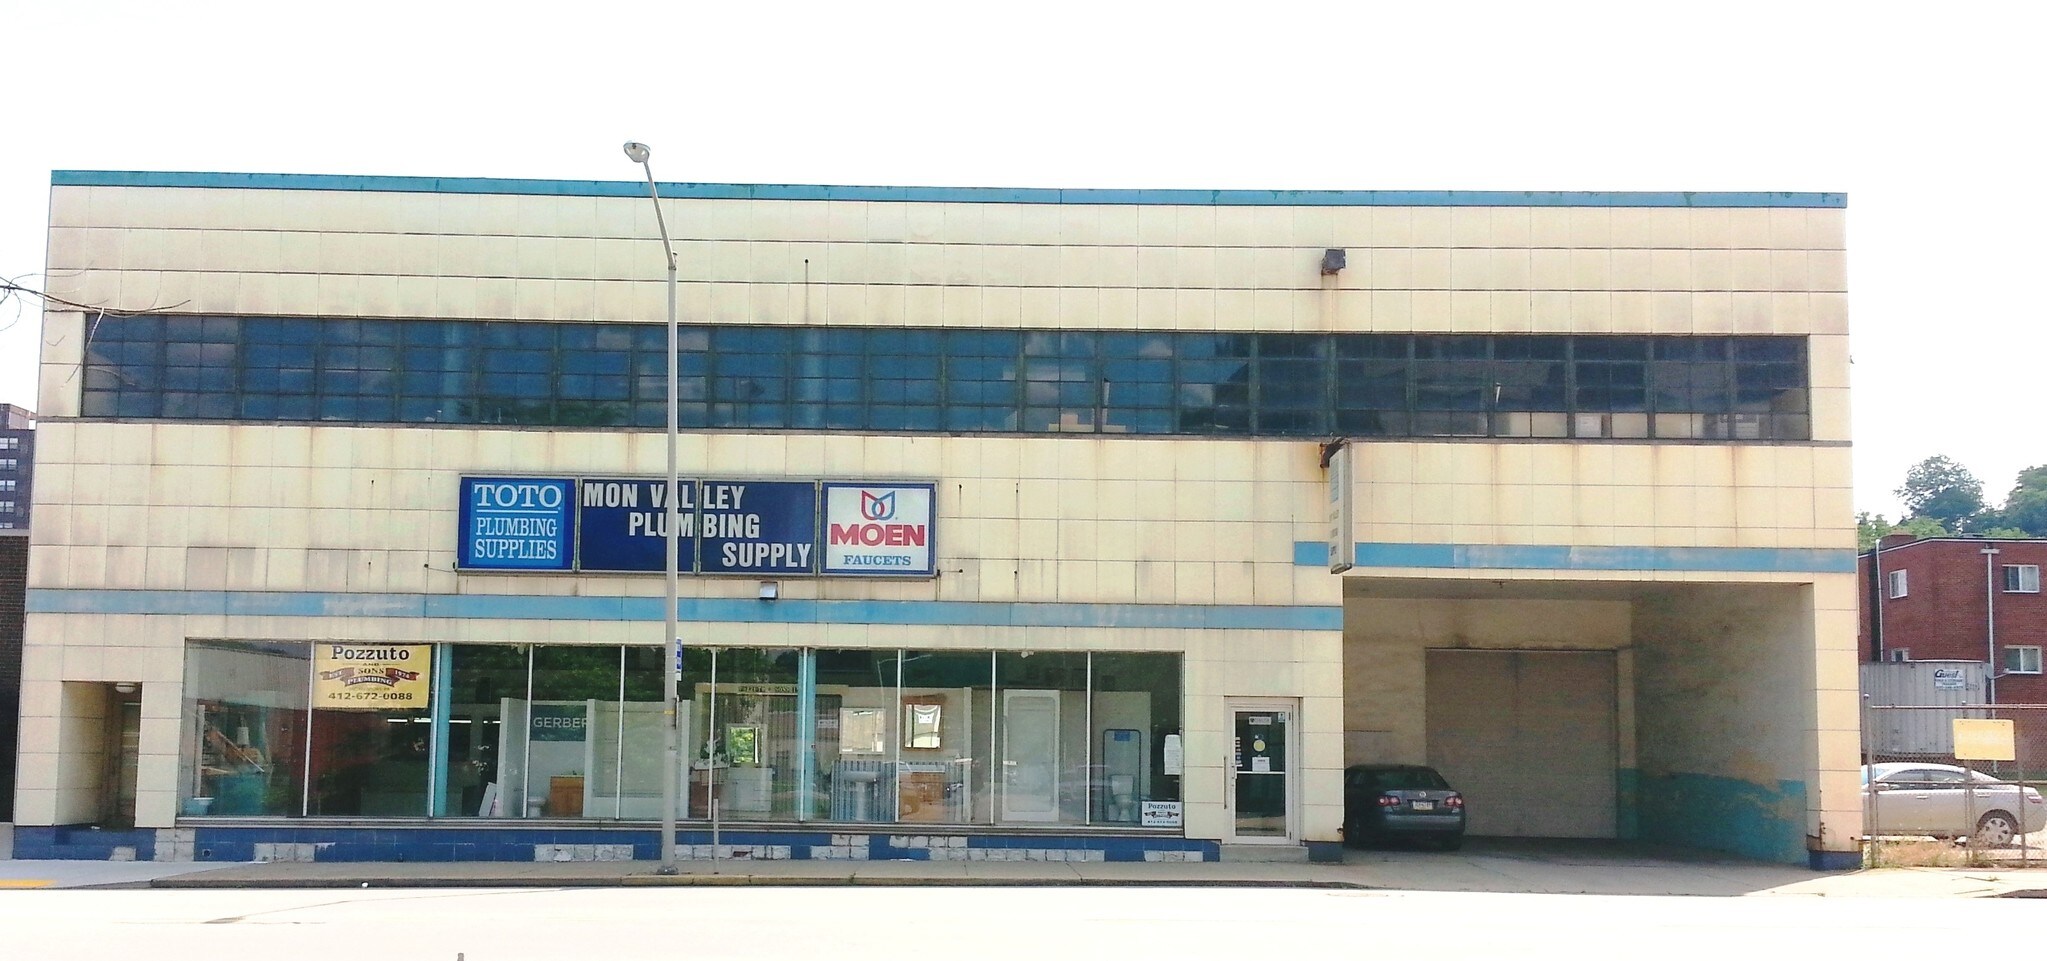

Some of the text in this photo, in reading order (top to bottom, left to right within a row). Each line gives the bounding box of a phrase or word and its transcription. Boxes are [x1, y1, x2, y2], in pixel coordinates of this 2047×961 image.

[474, 484, 562, 508] TOTO
[583, 482, 638, 508] MON
[475, 517, 558, 537] PLUMBING
[830, 523, 925, 547] MOEN
[475, 538, 557, 560] SUPPLIES
[722, 541, 812, 568] SUPPLY
[843, 554, 912, 566] FAUCETS
[331, 645, 410, 660] Pozzuto
[347, 676, 393, 686] PLUMBING
[328, 692, 413, 701] 412-672-0088
